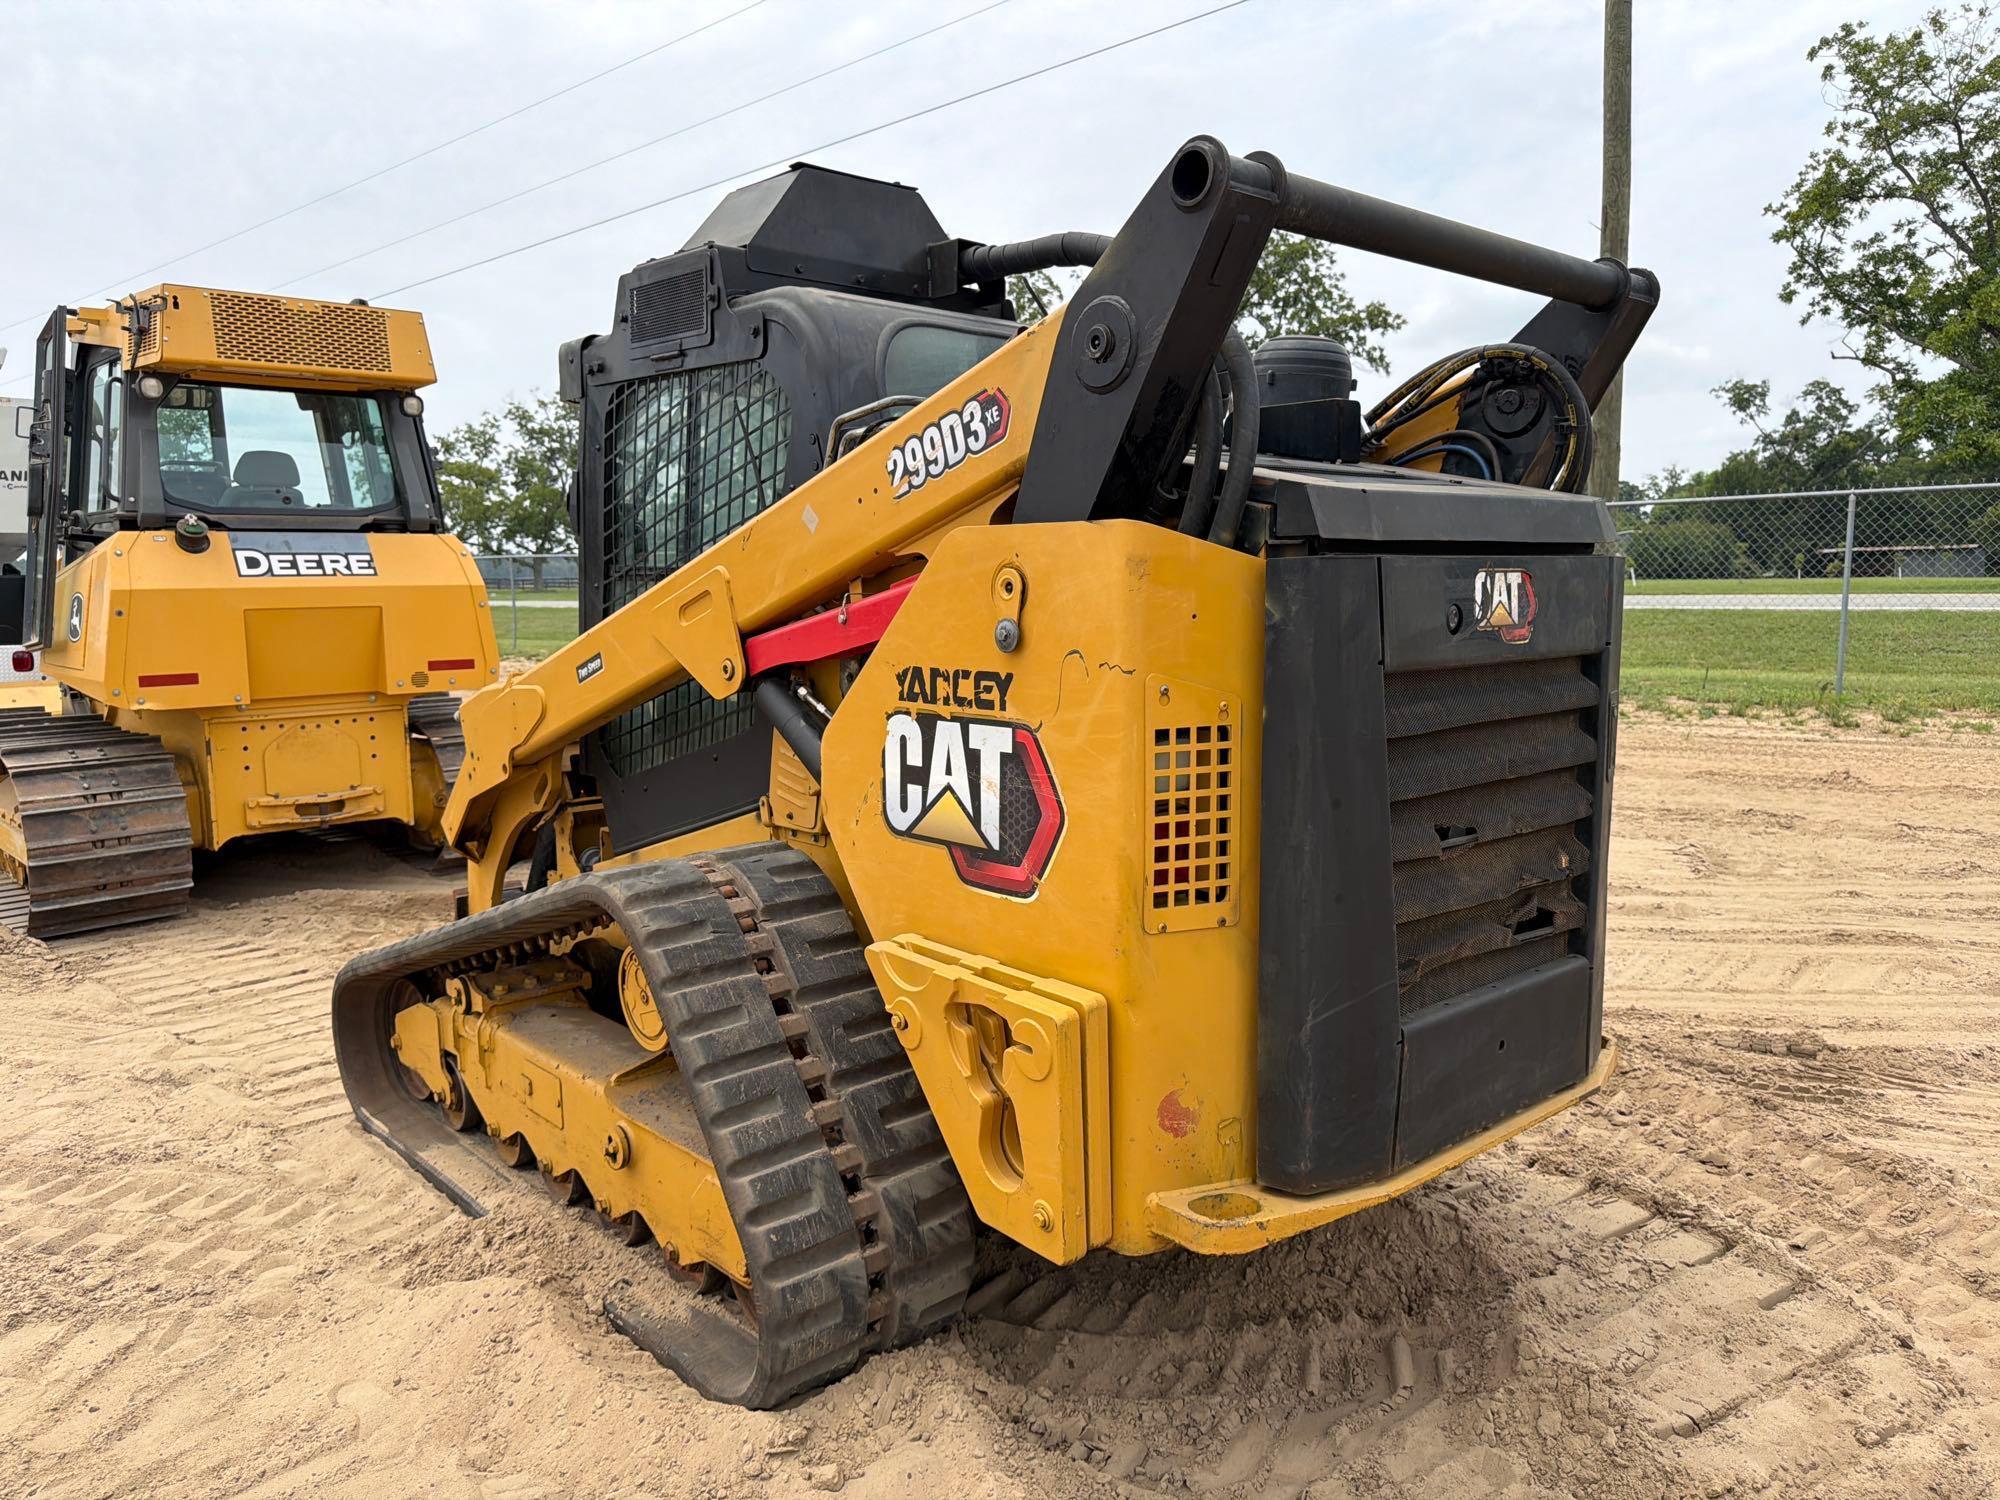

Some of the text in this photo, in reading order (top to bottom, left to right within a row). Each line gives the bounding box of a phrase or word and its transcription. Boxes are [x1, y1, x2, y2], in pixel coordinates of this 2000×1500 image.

[886, 400, 1001, 498] 299D3 XE
[234, 549, 375, 576] DEERE
[1474, 571, 1522, 626] CAT
[895, 665, 1014, 712] YANCEY
[884, 713, 1013, 851] CAT
